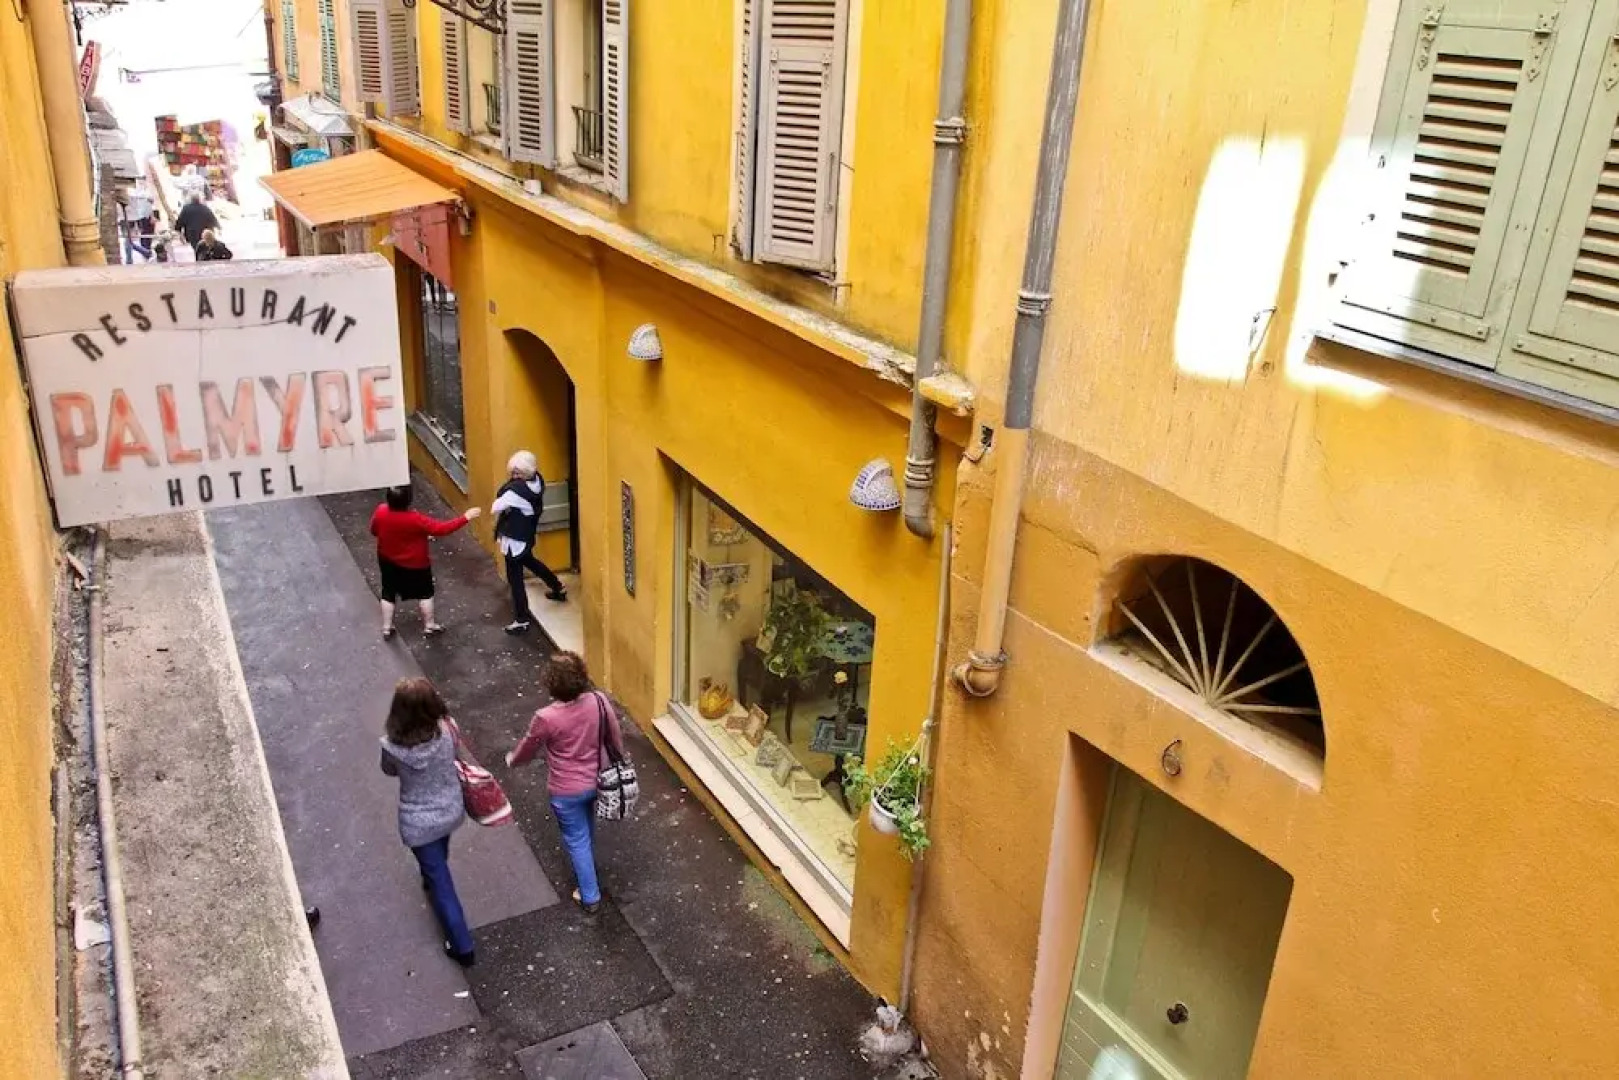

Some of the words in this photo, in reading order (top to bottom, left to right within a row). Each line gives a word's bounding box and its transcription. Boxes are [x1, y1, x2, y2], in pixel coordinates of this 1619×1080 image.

[72, 287, 357, 361] RESTAURANT
[51, 367, 396, 475] PALMYRE
[167, 465, 304, 506] HOTEL
[1162, 739, 1182, 777] 6
